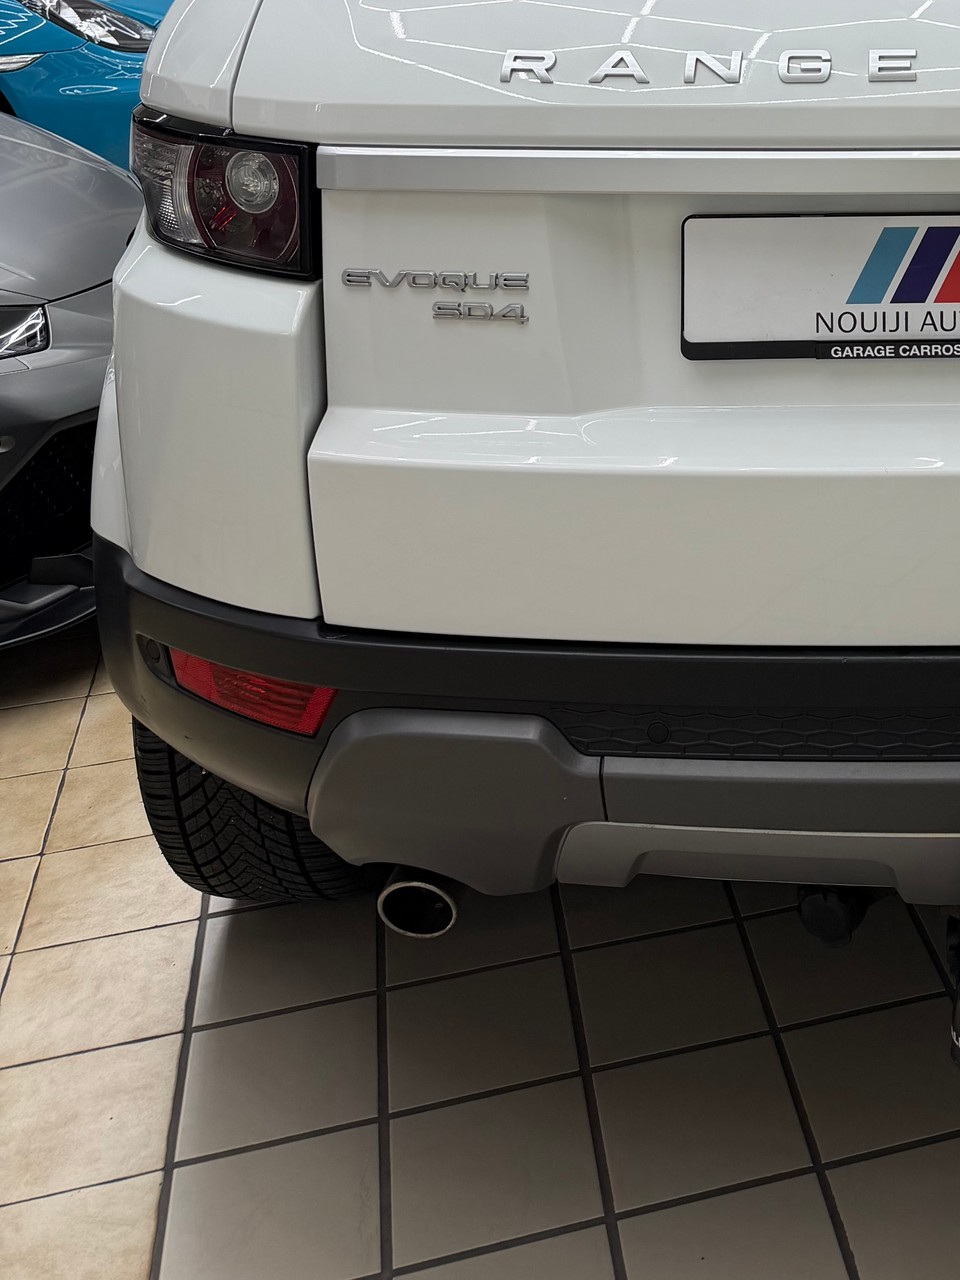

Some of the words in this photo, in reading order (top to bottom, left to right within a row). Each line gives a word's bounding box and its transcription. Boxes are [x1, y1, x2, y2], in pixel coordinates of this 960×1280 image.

[499, 49, 918, 84] RANGE
[341, 268, 530, 293] EVOQUE
[432, 301, 530, 325] SD4
[815, 311, 909, 333] NOUIJI
[830, 345, 895, 358] GARAGE
